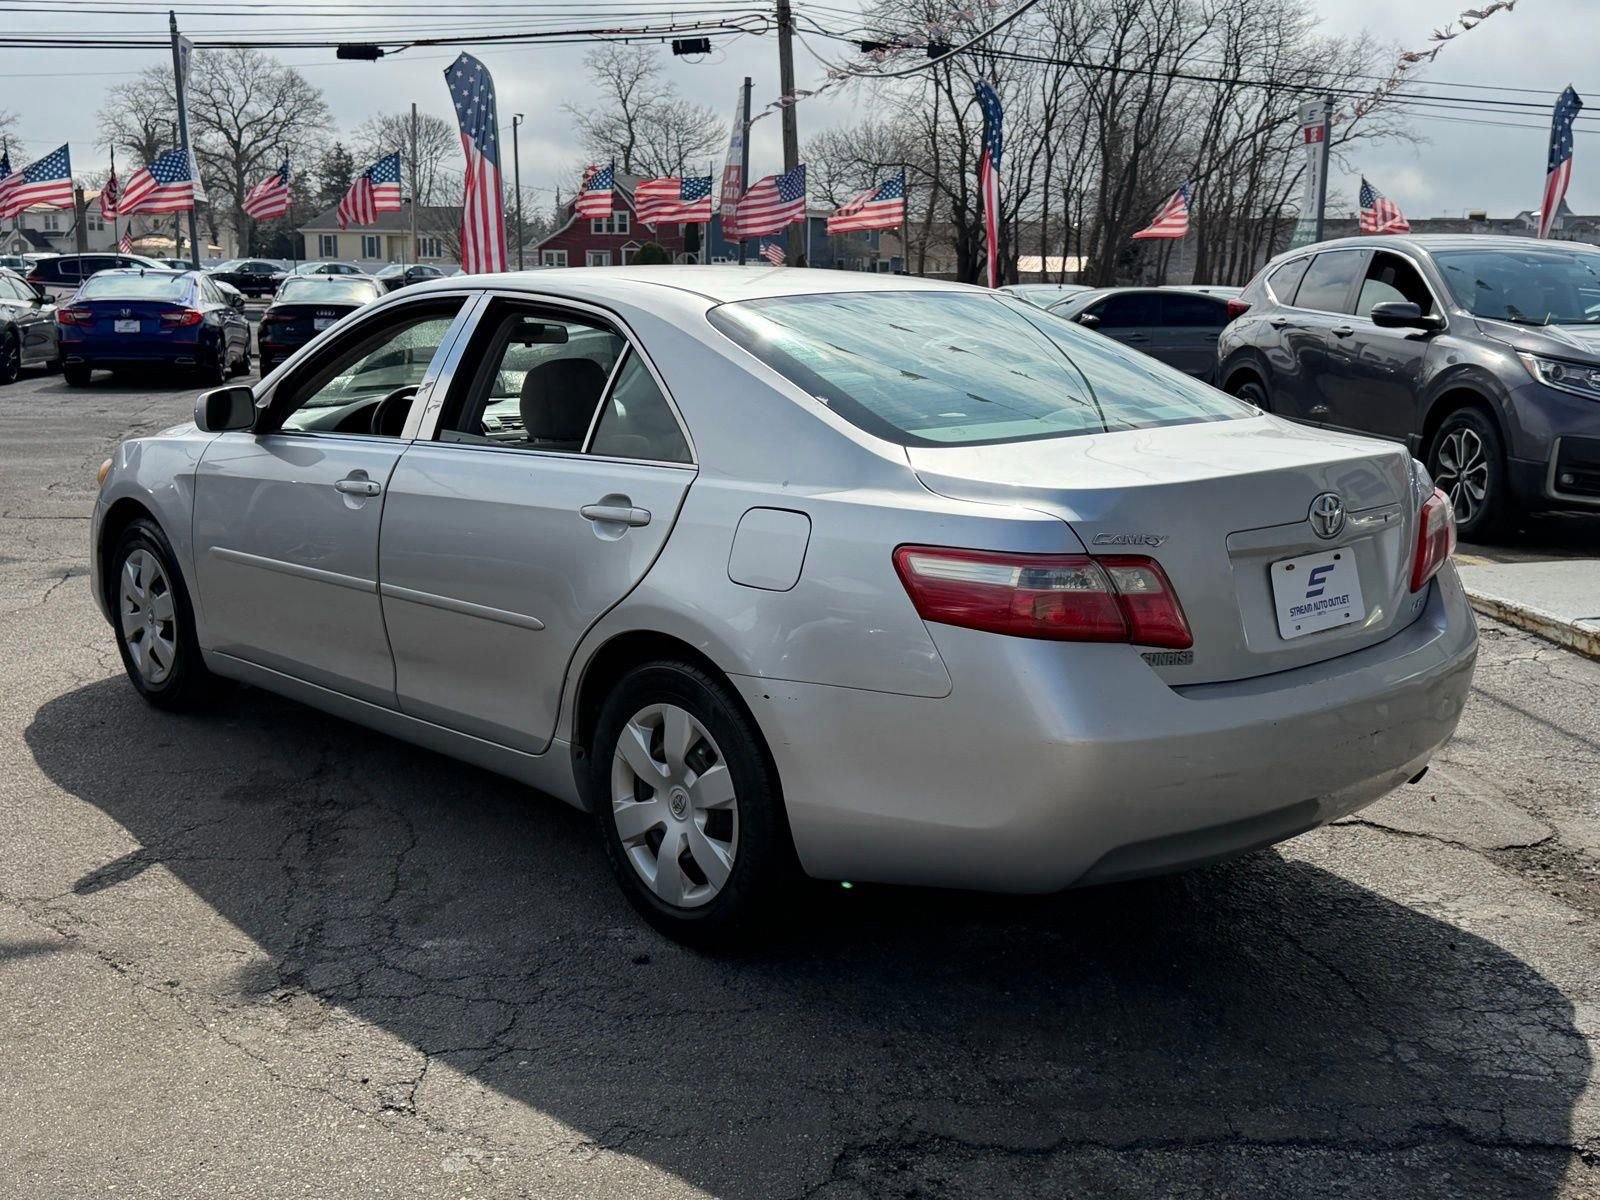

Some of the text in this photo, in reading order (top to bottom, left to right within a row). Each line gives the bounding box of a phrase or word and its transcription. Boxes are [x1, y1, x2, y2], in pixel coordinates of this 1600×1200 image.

[1092, 532, 1170, 548] CAMRY
[1289, 594, 1350, 617] STREAM AUTO OUTLET
